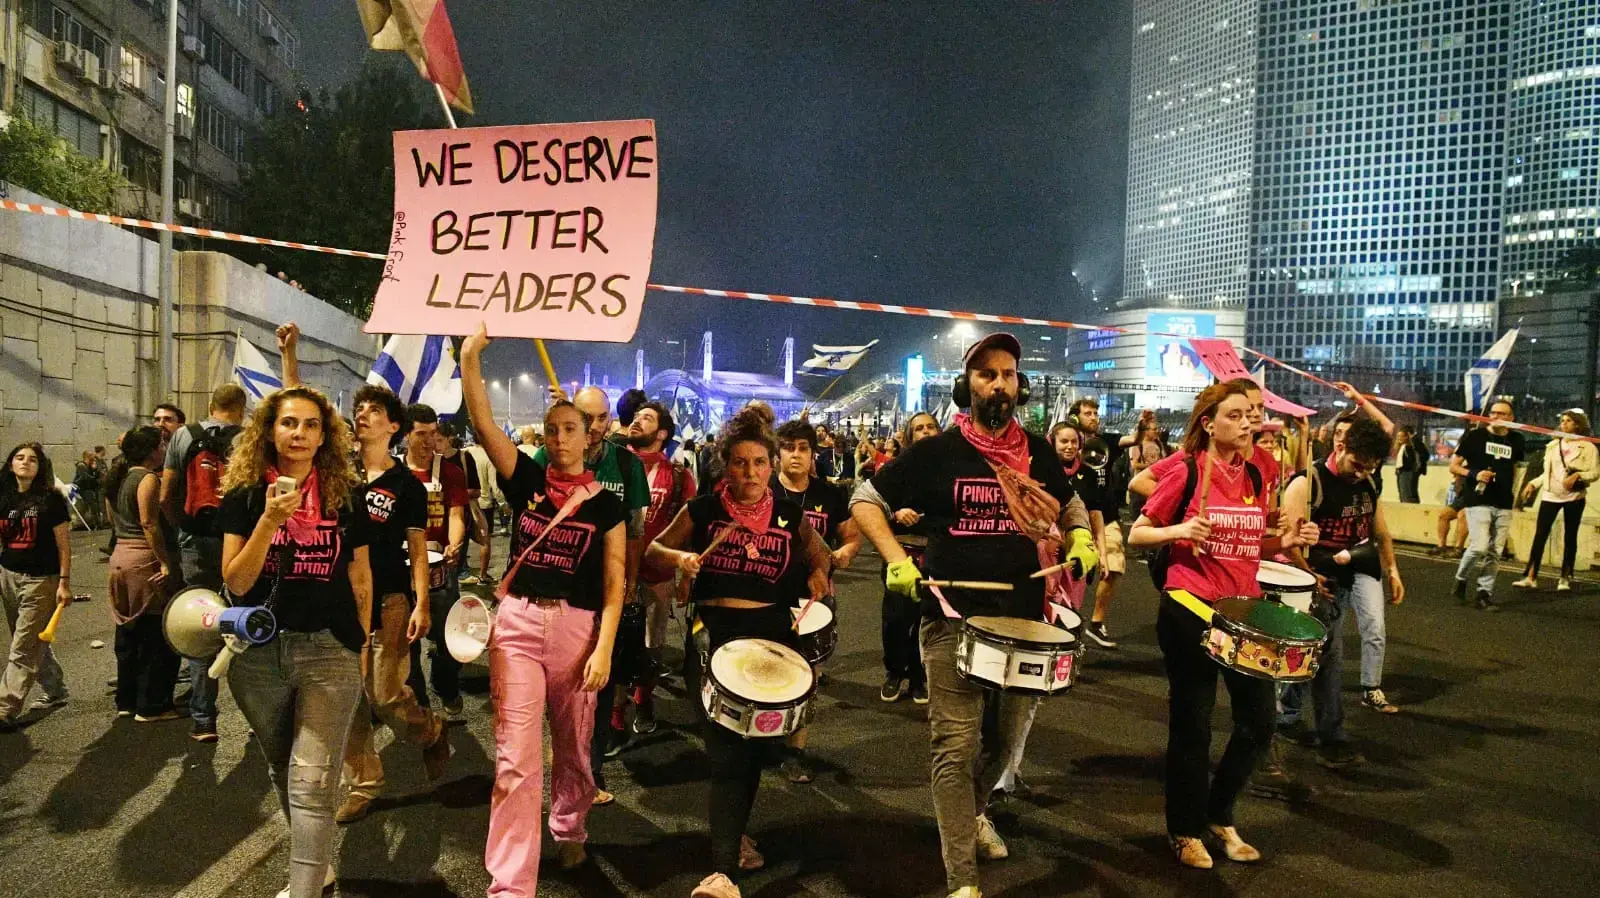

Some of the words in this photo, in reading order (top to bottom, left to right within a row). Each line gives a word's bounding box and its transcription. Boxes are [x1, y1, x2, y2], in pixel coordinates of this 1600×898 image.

[411, 142, 473, 188] WE
[494, 135, 654, 186] DESERVE
[430, 206, 609, 255] BETTER
[425, 271, 631, 317] LEADERS
[365, 491, 397, 512] FCK
[521, 515, 584, 546] PINKRONT
[958, 518, 995, 531] הורודה
[1210, 513, 1263, 530] PINKFRONT
[293, 561, 330, 575] החזית
